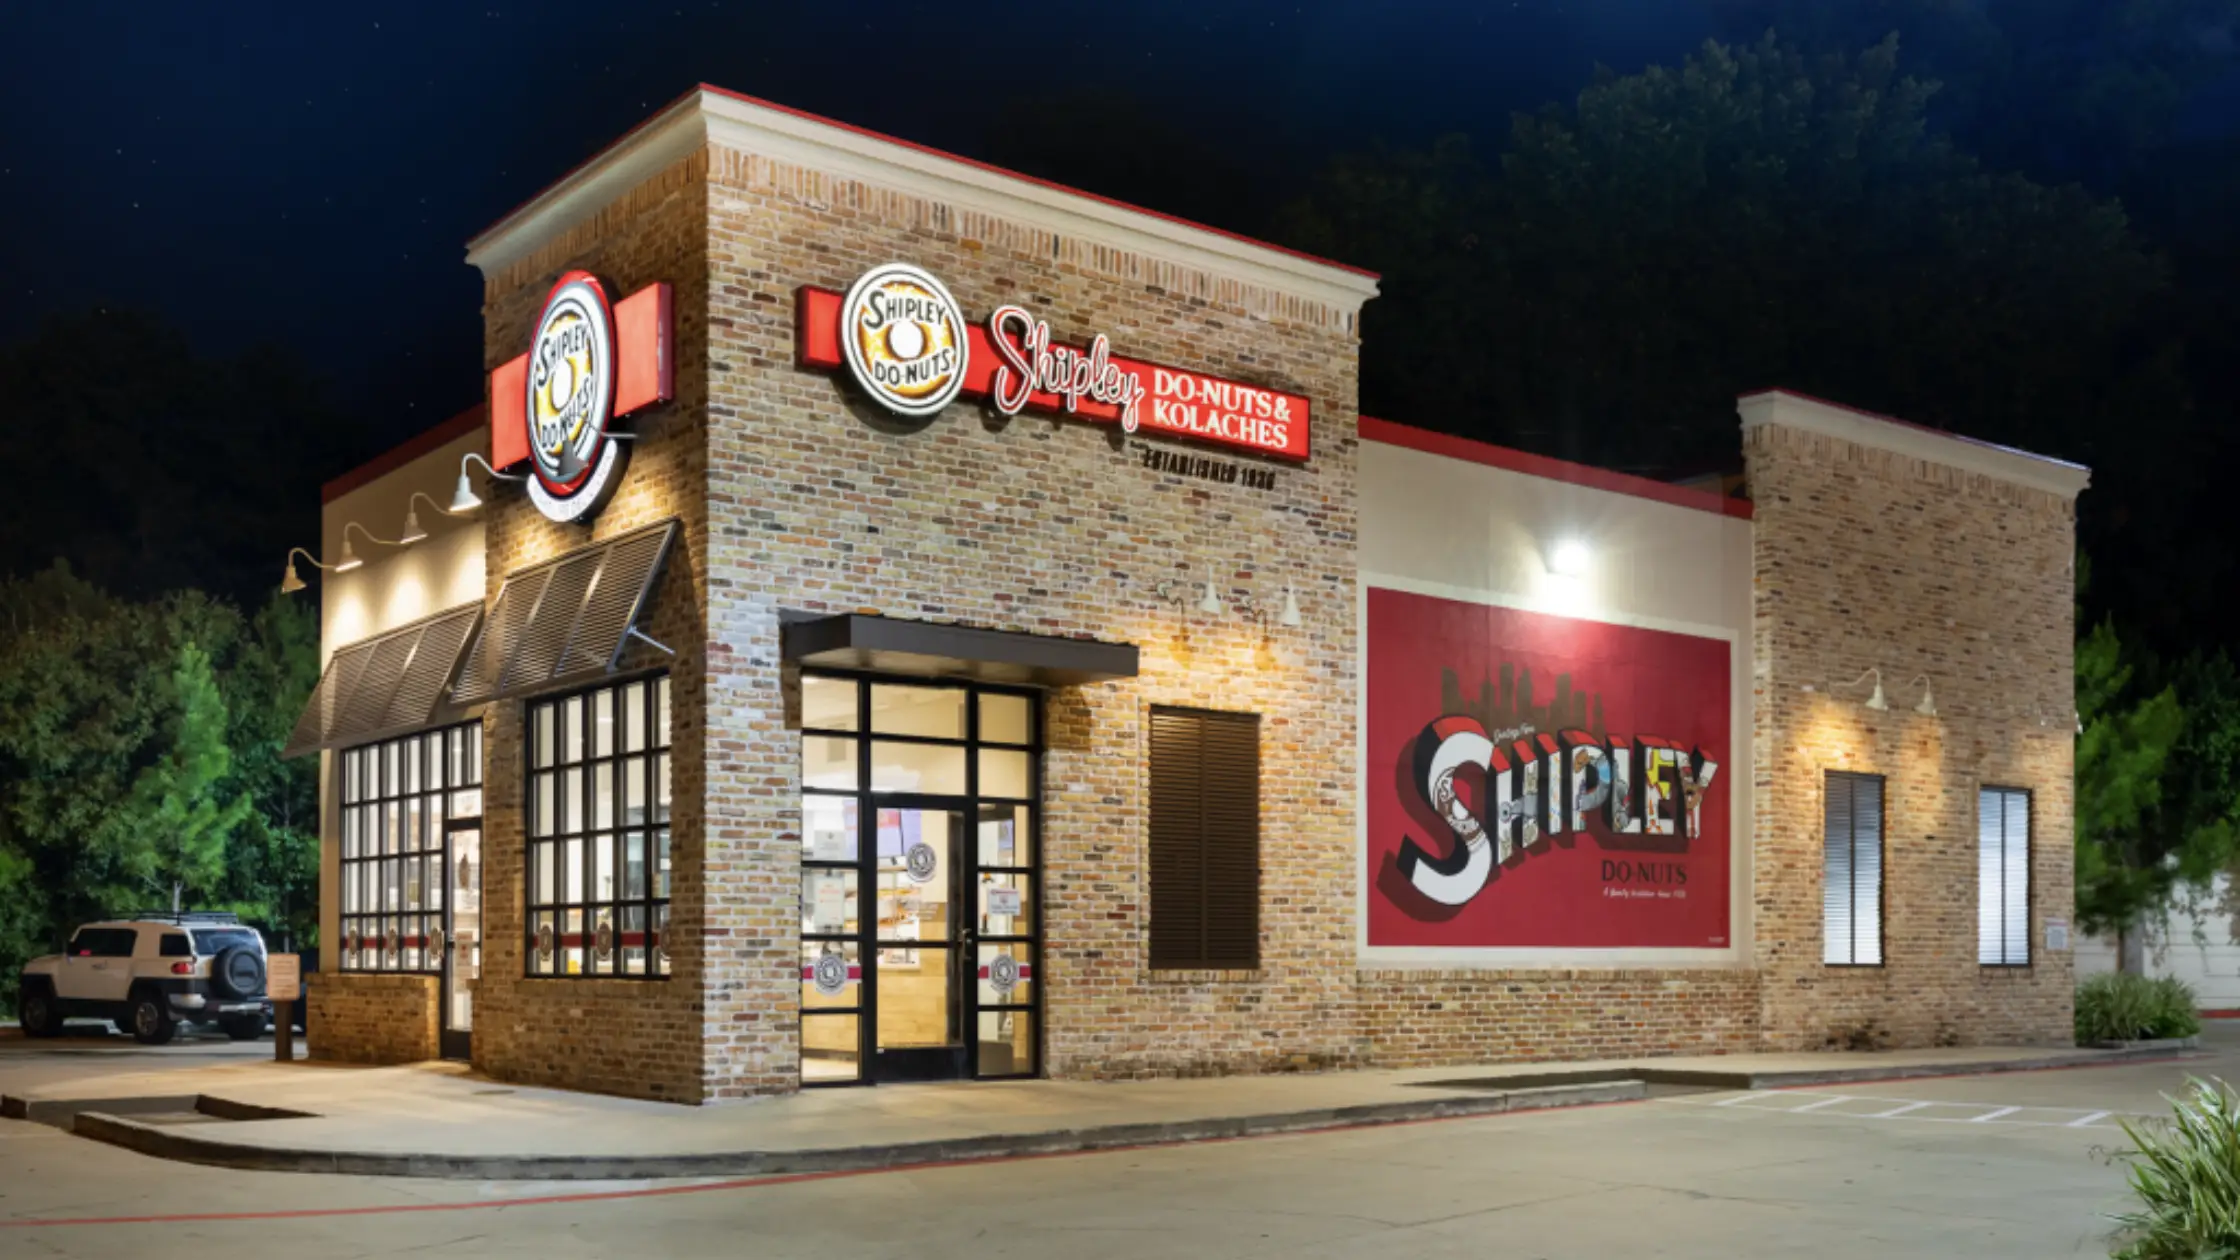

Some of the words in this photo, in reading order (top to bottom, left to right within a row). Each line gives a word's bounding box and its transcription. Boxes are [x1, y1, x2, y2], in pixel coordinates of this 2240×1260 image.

[864, 289, 946, 330] SHIPLEY
[537, 324, 587, 388] SHIPLEY
[991, 305, 1145, 433] Shipley
[1153, 398, 1290, 449] KOLACHES
[1397, 714, 1719, 906] SHIPLEY
